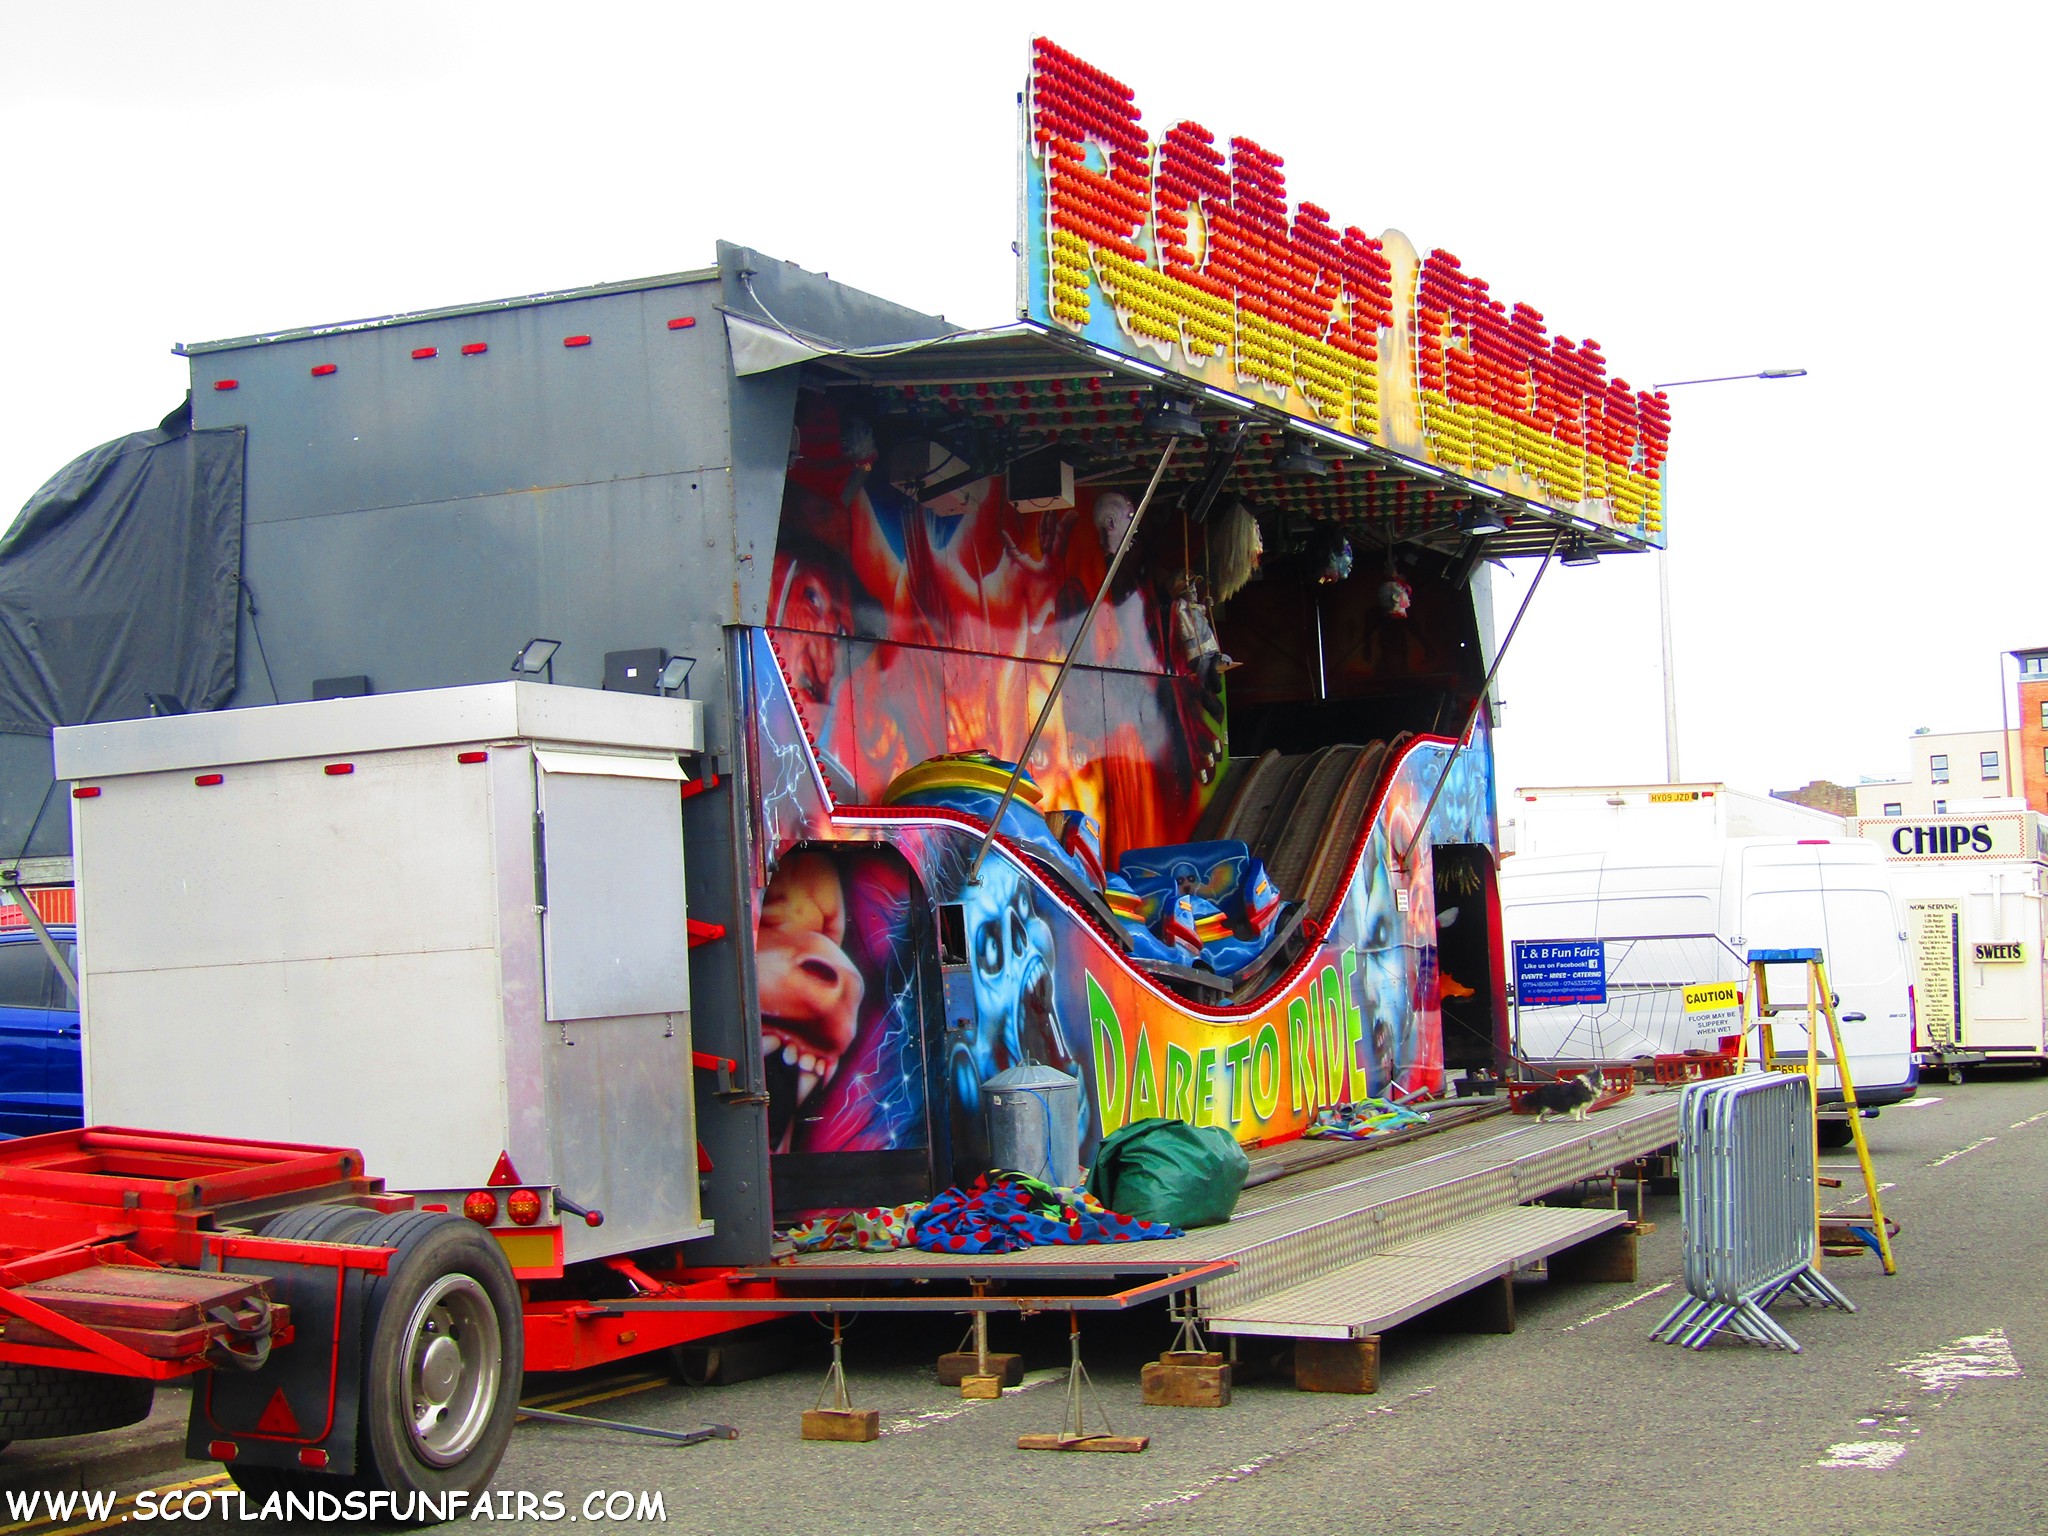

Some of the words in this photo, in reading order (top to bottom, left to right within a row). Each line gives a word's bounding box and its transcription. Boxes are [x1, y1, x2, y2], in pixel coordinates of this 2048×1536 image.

[1892, 824, 1992, 855] CHIPS
[1522, 950, 1527, 958] L
[1530, 949, 1538, 958] &
[1542, 949, 1548, 958] B
[1552, 948, 1571, 958] Fun
[1574, 946, 1600, 957] Fairs
[1976, 945, 2020, 959] SWEETS
[1686, 989, 1733, 1004] CAUTION
[1688, 1013, 1711, 1022] FLOOR
[1698, 1020, 1728, 1028] SLIPPERY
[1085, 968, 1218, 1138] DARE
[1226, 1022, 1280, 1123] TO
[1287, 943, 1368, 1117] RIDE
